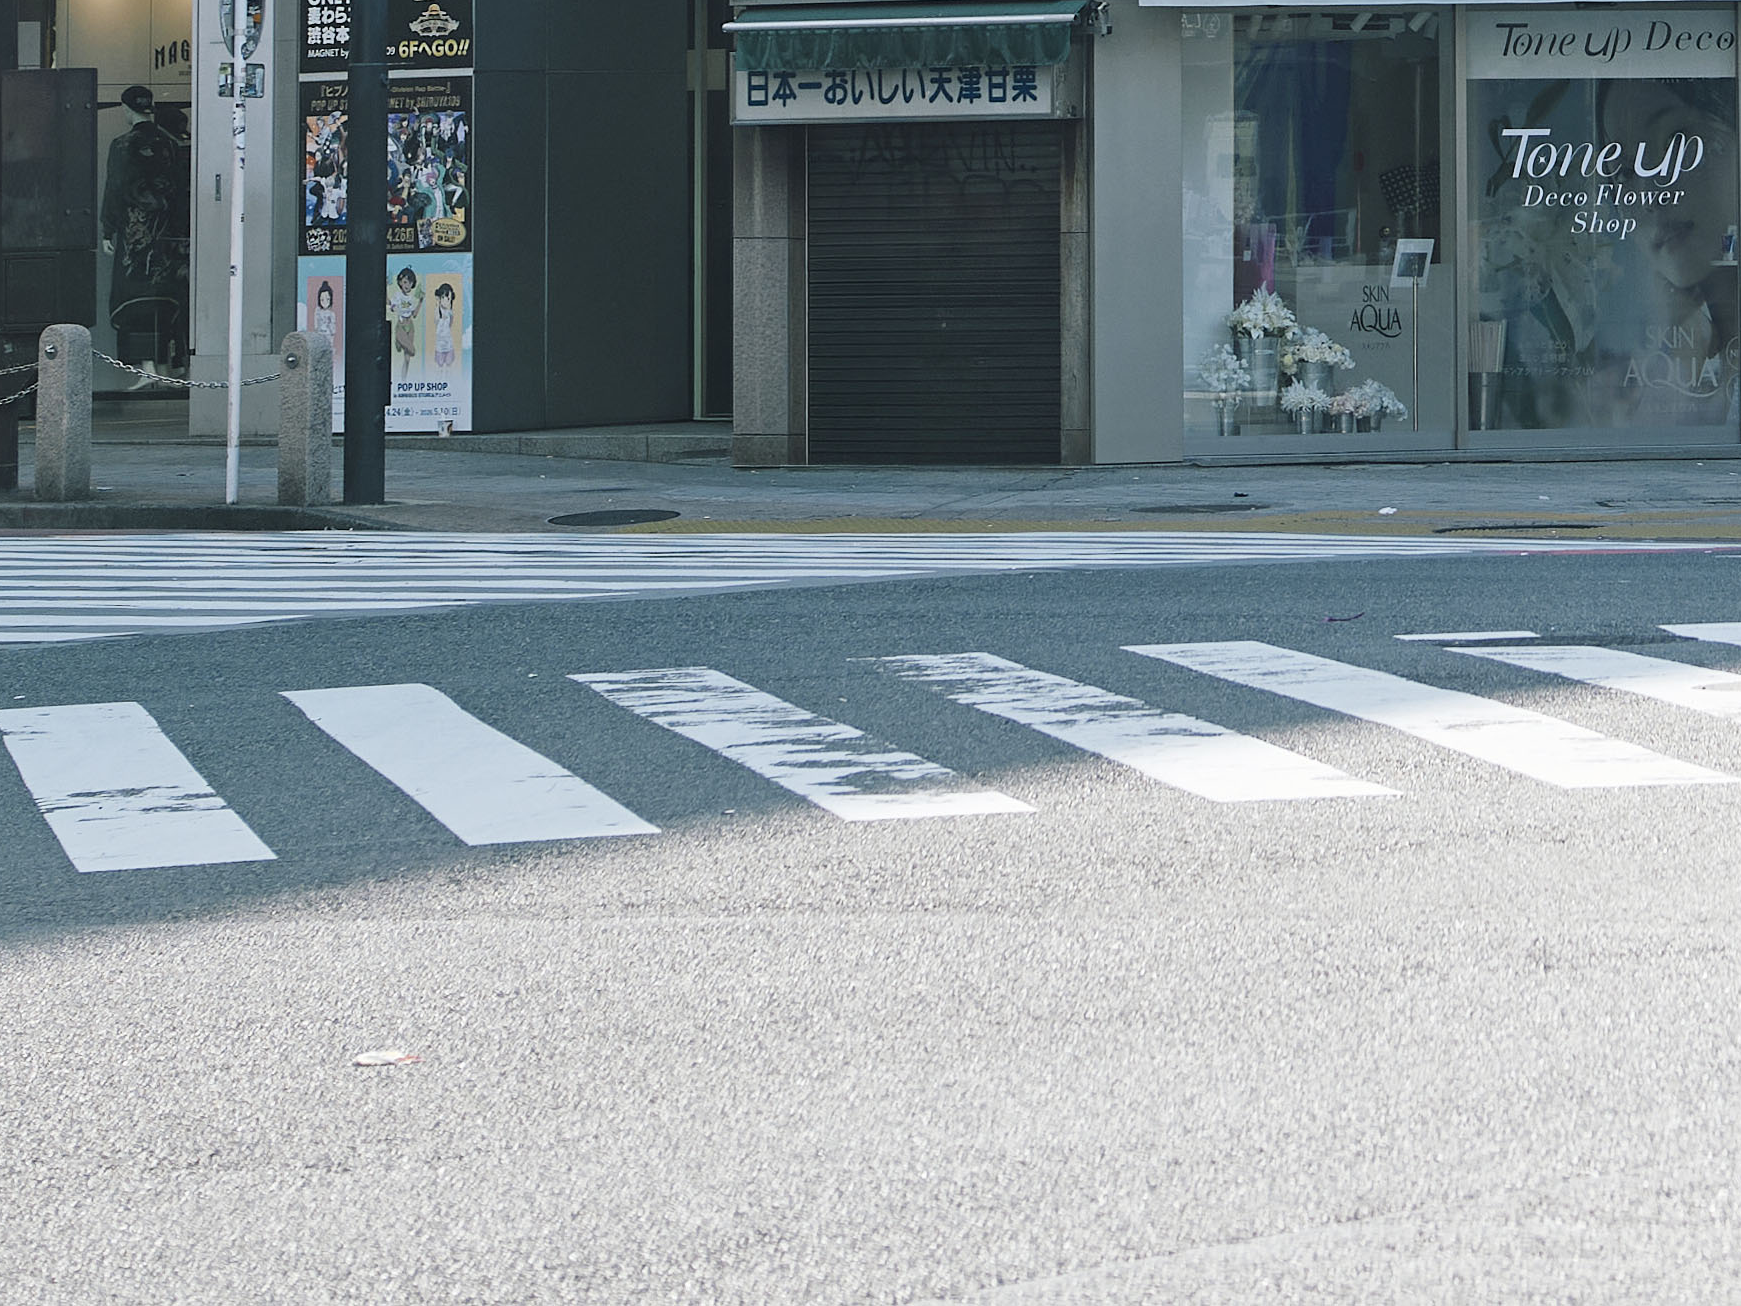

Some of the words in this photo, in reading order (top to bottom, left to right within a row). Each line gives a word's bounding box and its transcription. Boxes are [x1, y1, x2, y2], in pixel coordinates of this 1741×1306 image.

[1644, 19, 1736, 54] Deco
[308, 49, 340, 59] MAGNET
[745, 61, 1041, 111] 日本一おいしい天津甘栗
[1502, 128, 1622, 180] Tone
[1523, 184, 1588, 209] Deco
[1594, 184, 1686, 209] Flower
[1570, 212, 1638, 240] Shop
[1362, 285, 1390, 303] SKIN
[1350, 304, 1402, 338] AQUA
[1645, 324, 1696, 350] SKIN
[398, 382, 413, 392] POP
[415, 382, 425, 391] UP
[426, 382, 448, 391] SHOP
[1623, 349, 1720, 398] AQUA
